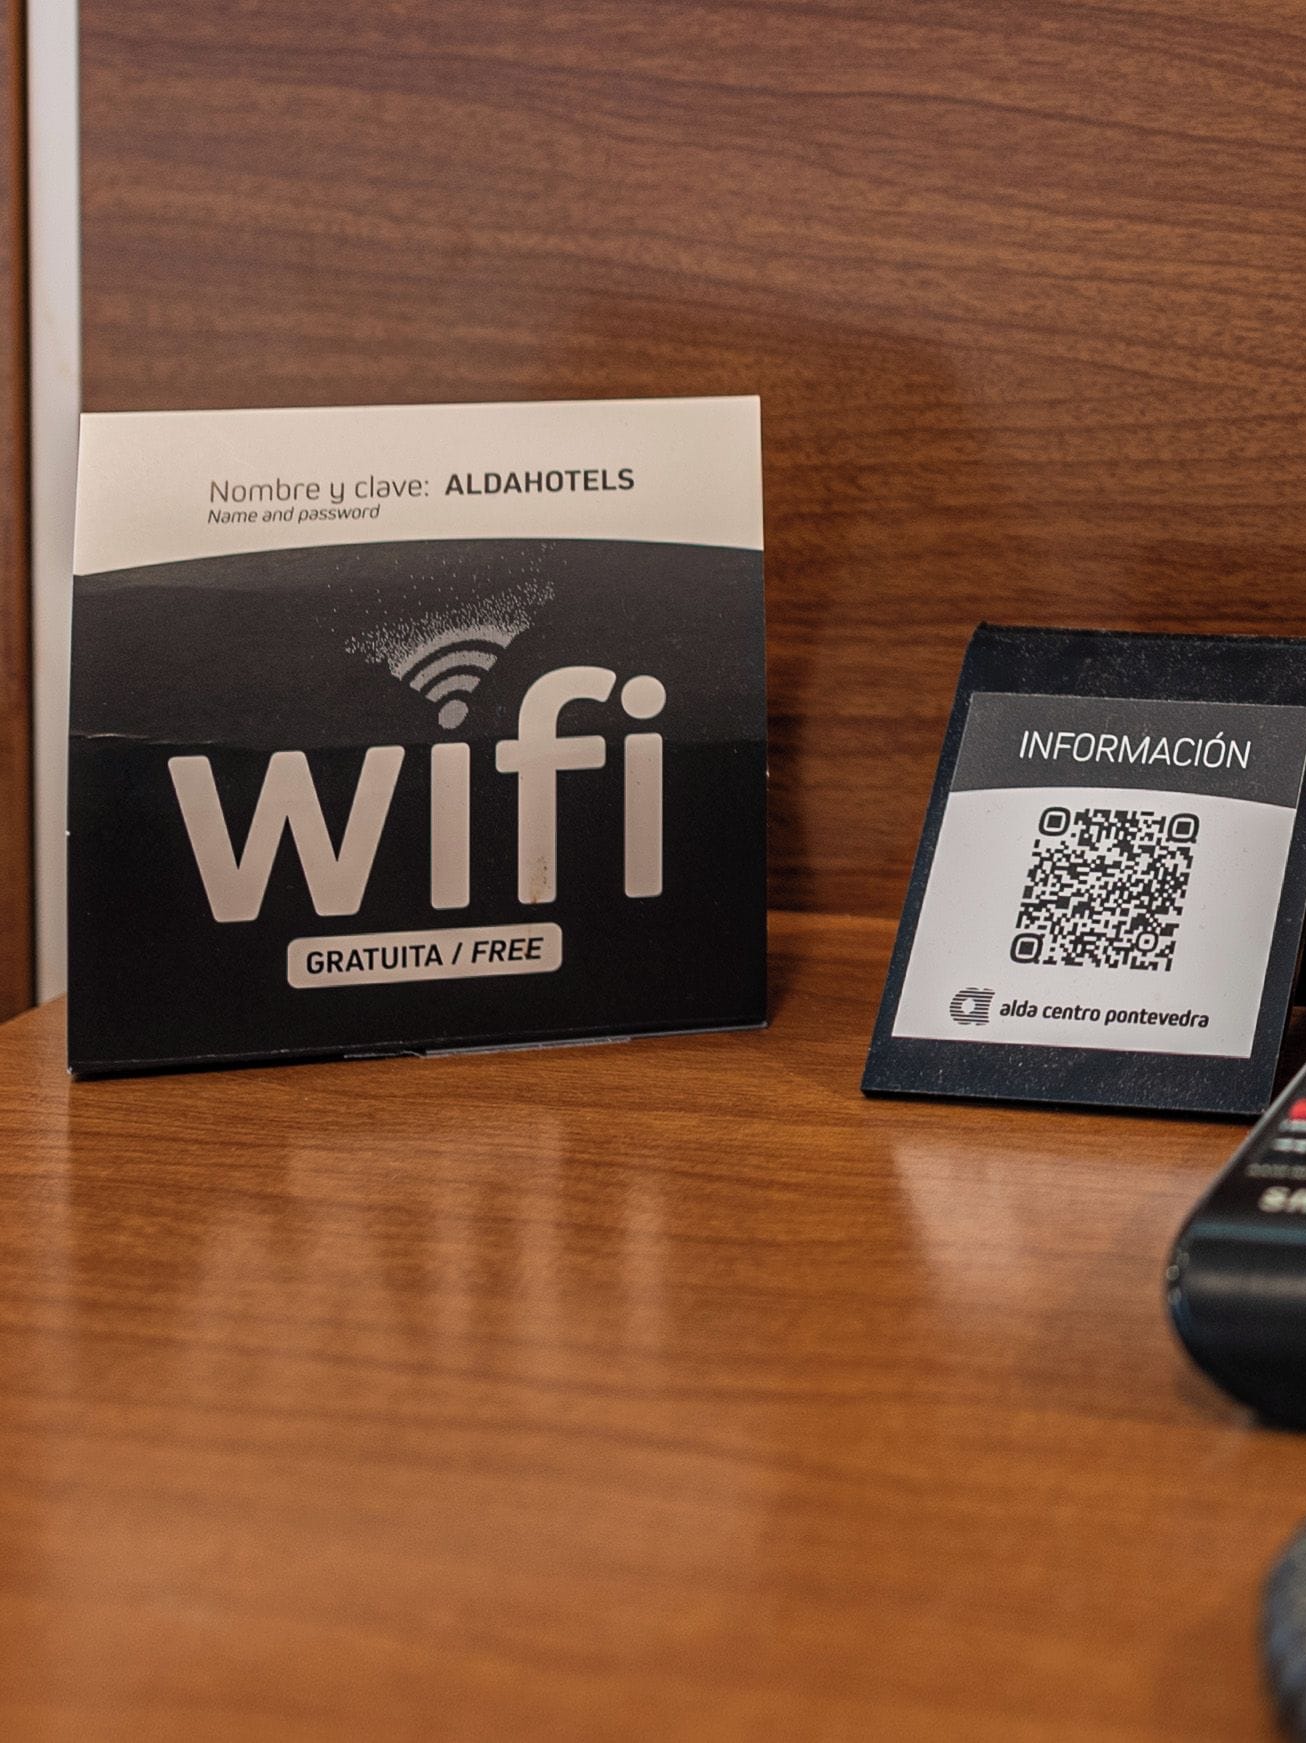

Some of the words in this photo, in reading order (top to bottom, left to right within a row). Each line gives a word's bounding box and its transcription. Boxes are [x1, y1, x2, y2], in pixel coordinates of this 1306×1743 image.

[209, 477, 320, 503] Nombre
[330, 482, 345, 505] y
[354, 475, 429, 498] clave:
[444, 468, 635, 496] ALDAHOTELS
[207, 508, 257, 525] Name
[262, 506, 294, 523] and
[297, 504, 381, 525] password
[1018, 729, 1252, 769] INFORMACIÓN
[167, 665, 667, 923] wifi
[306, 943, 444, 975] GRATUITA
[451, 941, 463, 966] /
[471, 936, 545, 964] FREE
[999, 999, 1038, 1018] alda
[1042, 1003, 1101, 1022] centro
[1104, 1008, 1210, 1029] pontevedra
